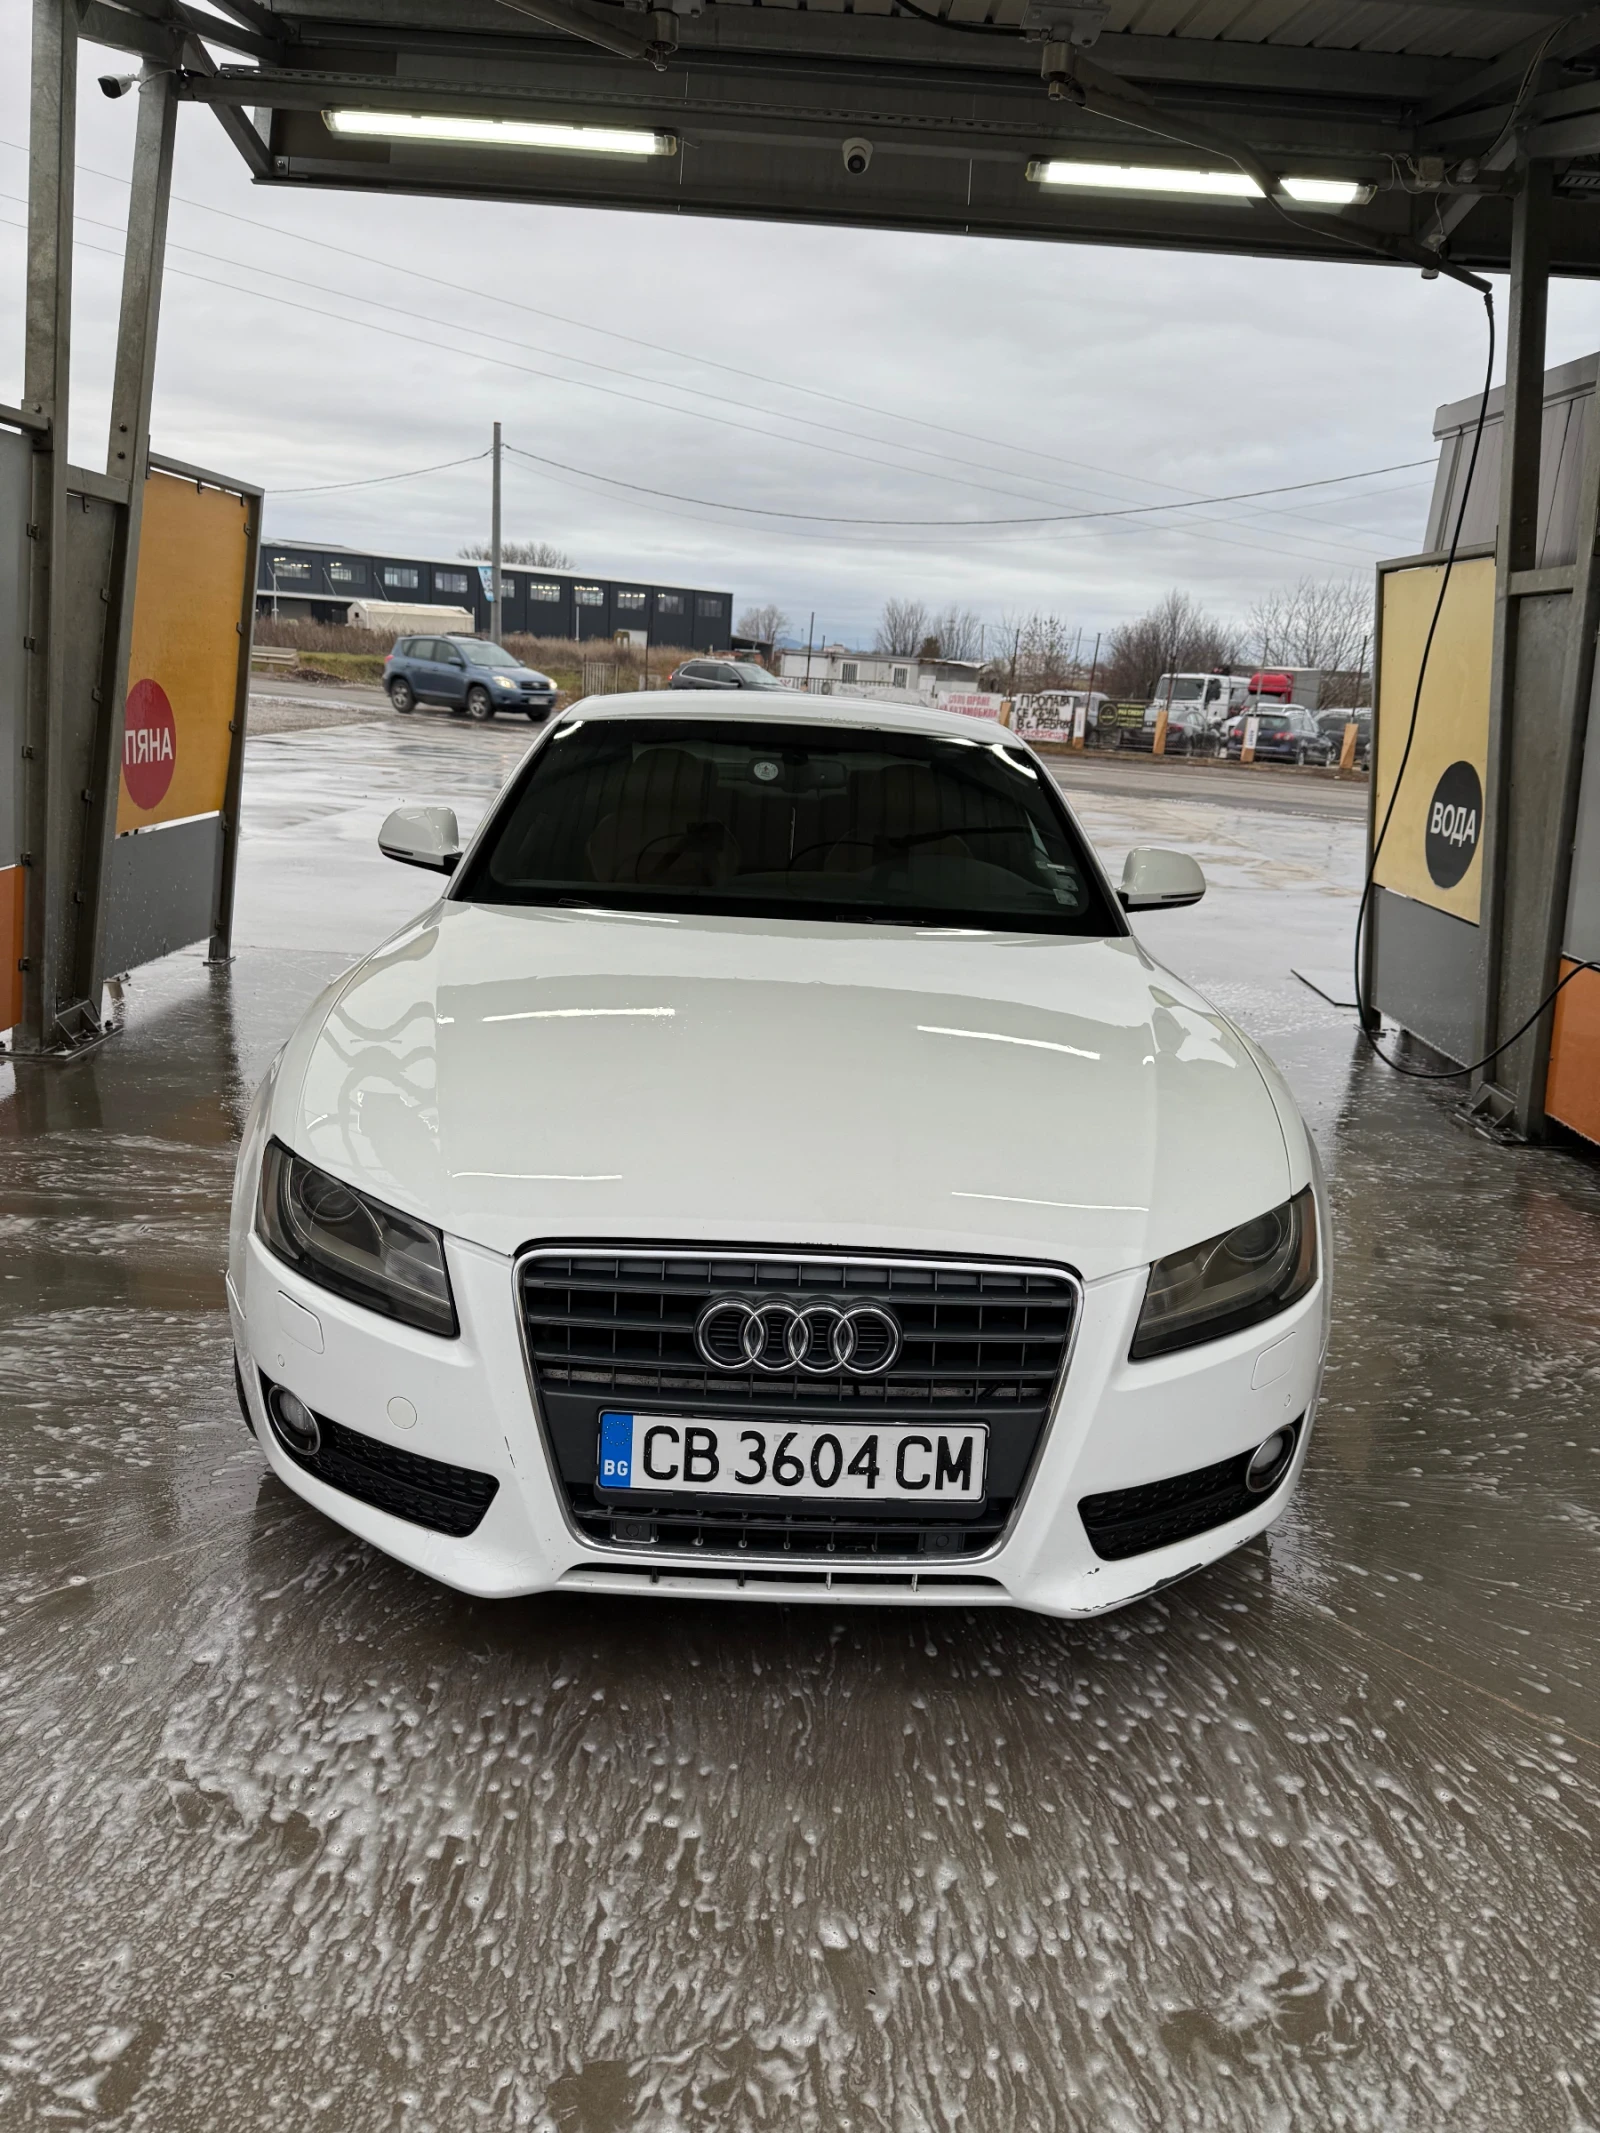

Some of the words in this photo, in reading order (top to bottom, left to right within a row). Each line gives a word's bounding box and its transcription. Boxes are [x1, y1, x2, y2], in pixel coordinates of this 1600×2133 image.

[125, 727, 173, 765] ПЯНА
[1430, 801, 1476, 848] ВОДА
[604, 1459, 628, 1476] BG
[643, 1425, 720, 1482] CB
[734, 1430, 880, 1489] 3604
[895, 1435, 973, 1491] CM
